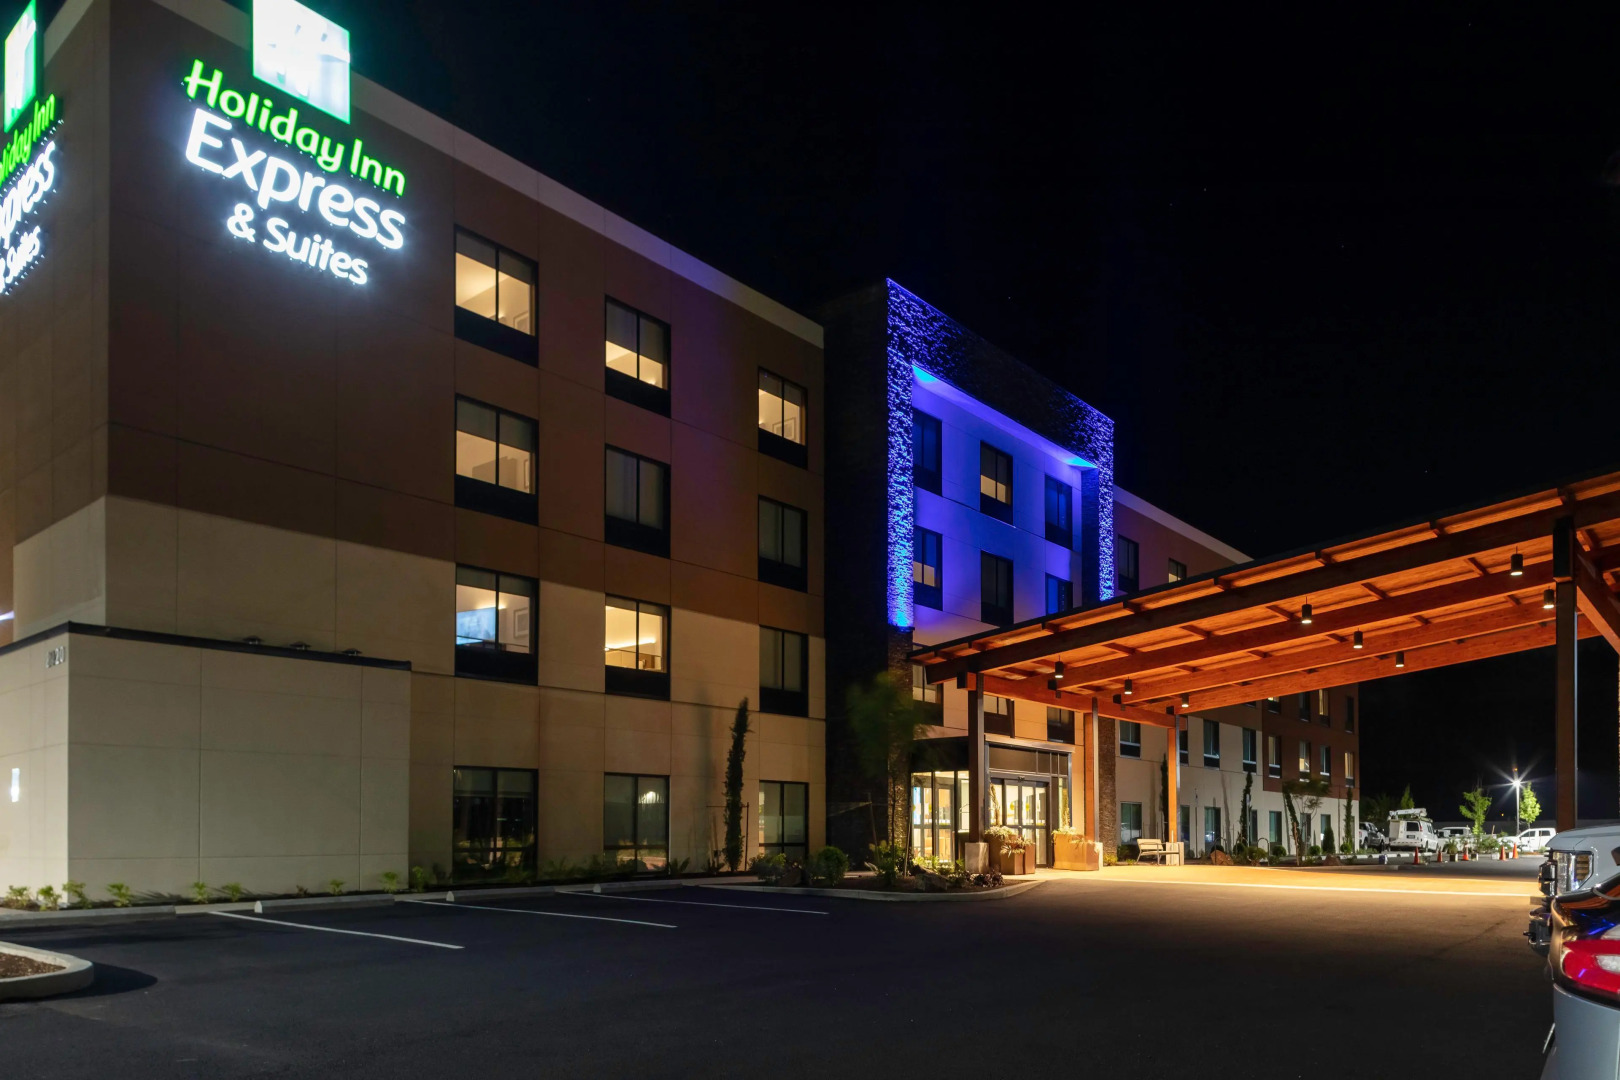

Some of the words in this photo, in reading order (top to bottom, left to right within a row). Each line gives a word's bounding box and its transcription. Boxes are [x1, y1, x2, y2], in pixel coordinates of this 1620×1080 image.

[33, 93, 55, 142] Inn
[184, 58, 345, 173] Holiday
[349, 138, 406, 197] Inn
[185, 107, 406, 250] Express
[226, 202, 256, 243] &
[262, 216, 369, 286] Suites
